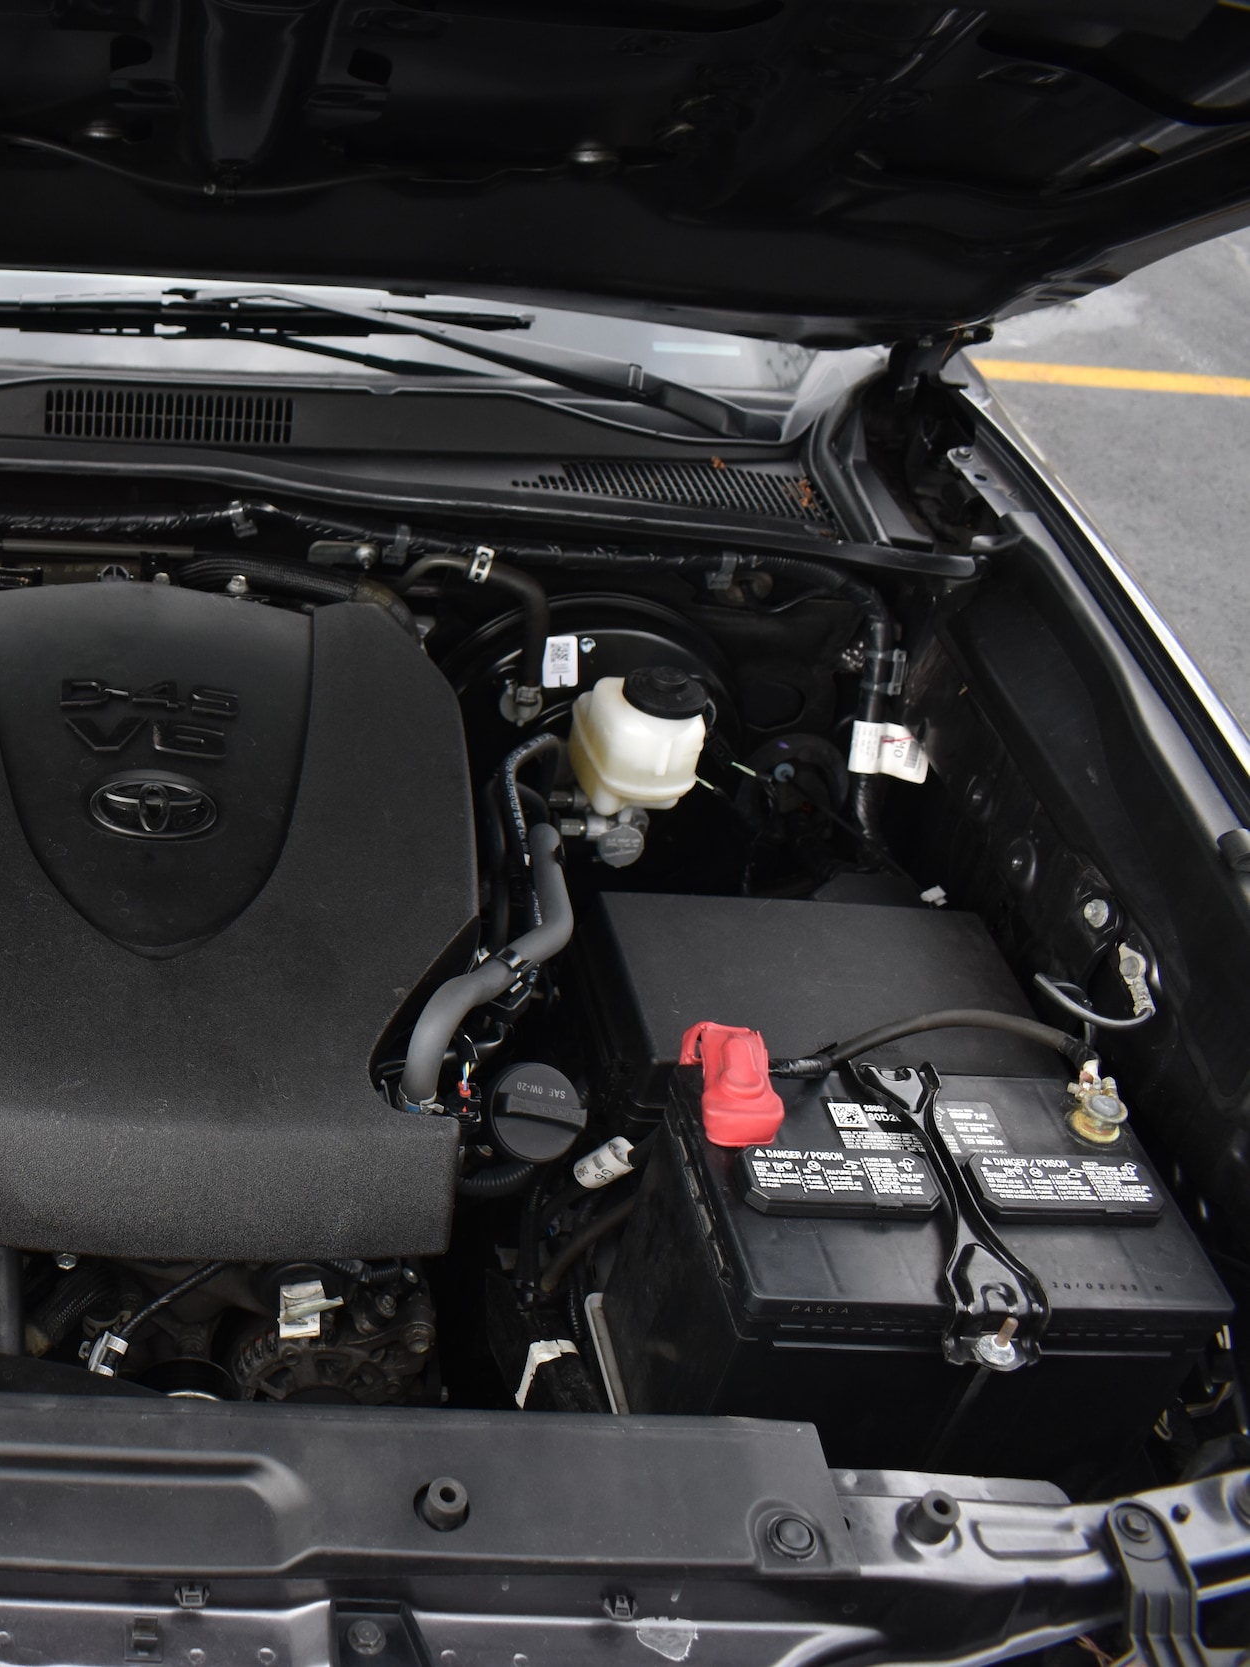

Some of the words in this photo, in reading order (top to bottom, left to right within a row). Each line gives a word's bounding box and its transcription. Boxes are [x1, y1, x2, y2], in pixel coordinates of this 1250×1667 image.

[65, 716, 227, 760] V6
[548, 1088, 566, 1100] SAE
[765, 1149, 802, 1159] DANGER
[810, 1151, 844, 1161] POISON
[993, 1157, 1028, 1167] DANGER
[1036, 1159, 1069, 1168] POISON
